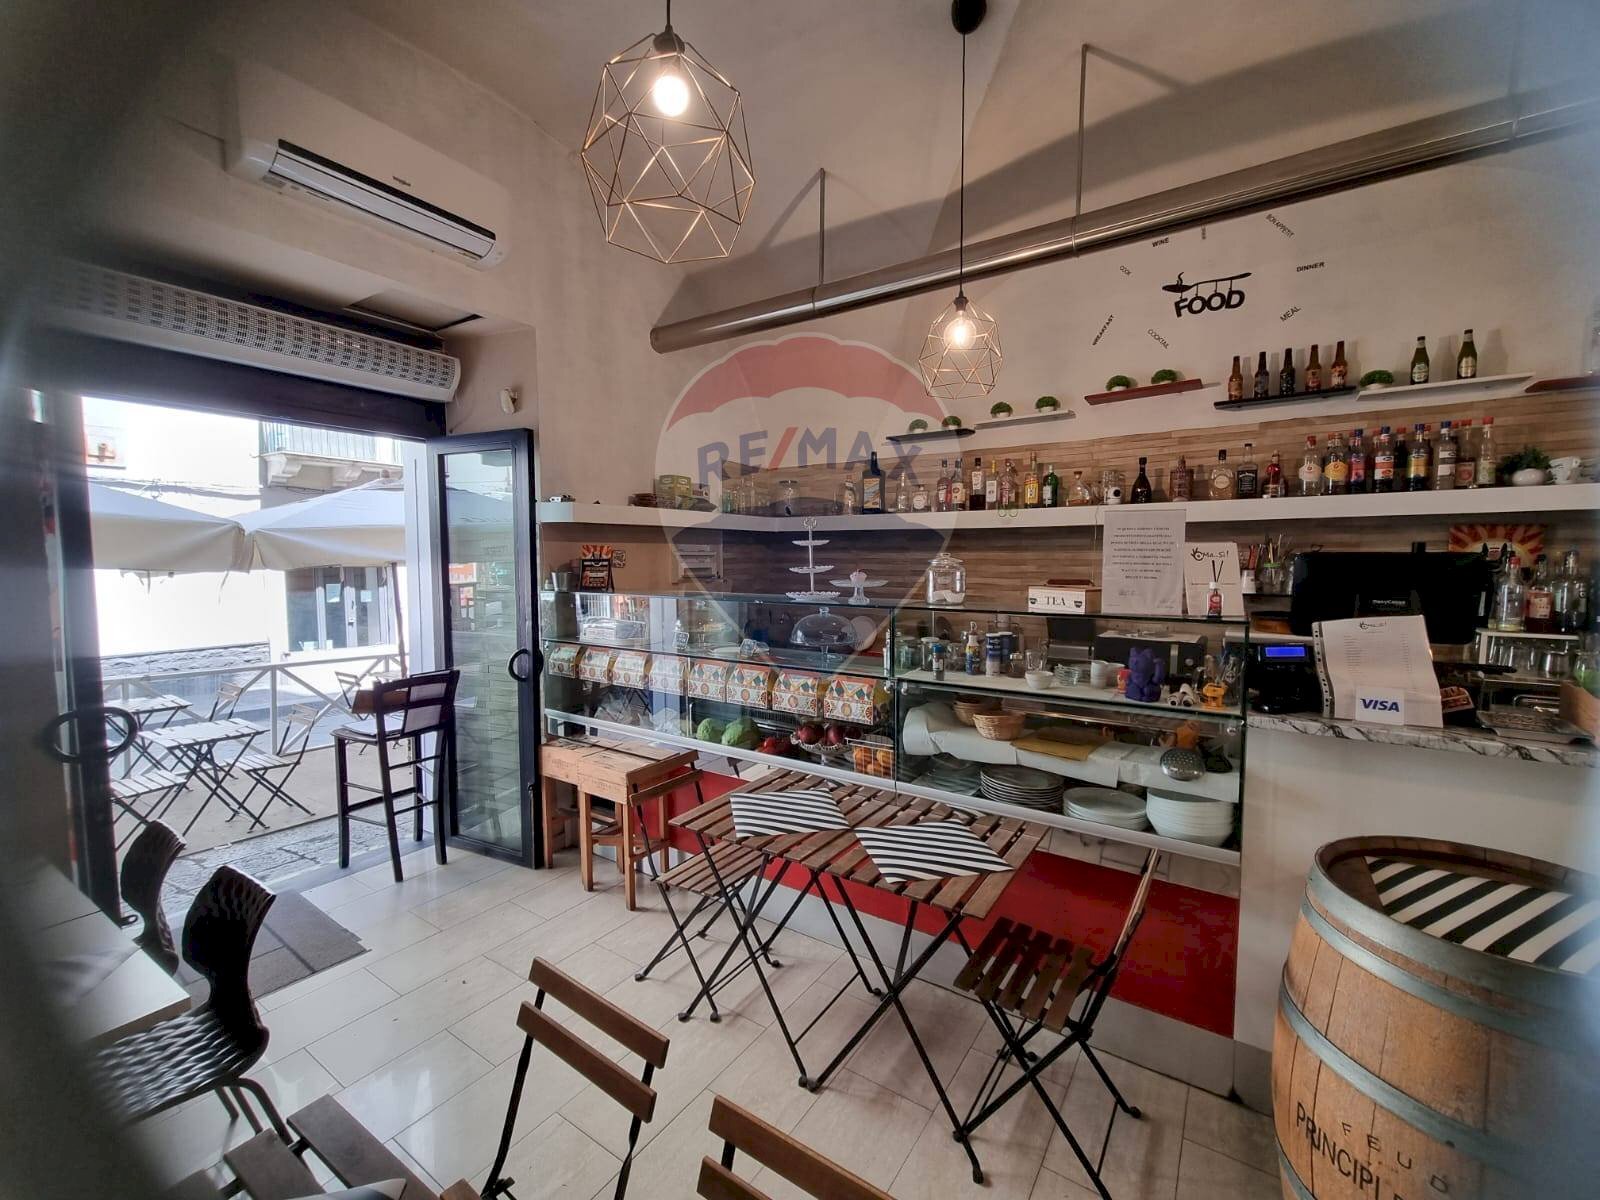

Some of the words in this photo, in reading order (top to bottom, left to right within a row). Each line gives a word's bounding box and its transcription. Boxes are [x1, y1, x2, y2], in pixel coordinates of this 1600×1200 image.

[1151, 237, 1170, 248] WINE
[1296, 261, 1325, 272] DINNER
[1174, 290, 1246, 318] FOOD
[1279, 305, 1301, 322] MEAL
[1147, 328, 1170, 350] COCKTAIL
[1045, 596, 1066, 606] TEA
[1360, 698, 1400, 713] VISA
[1296, 1101, 1381, 1200] PRINCIPI
